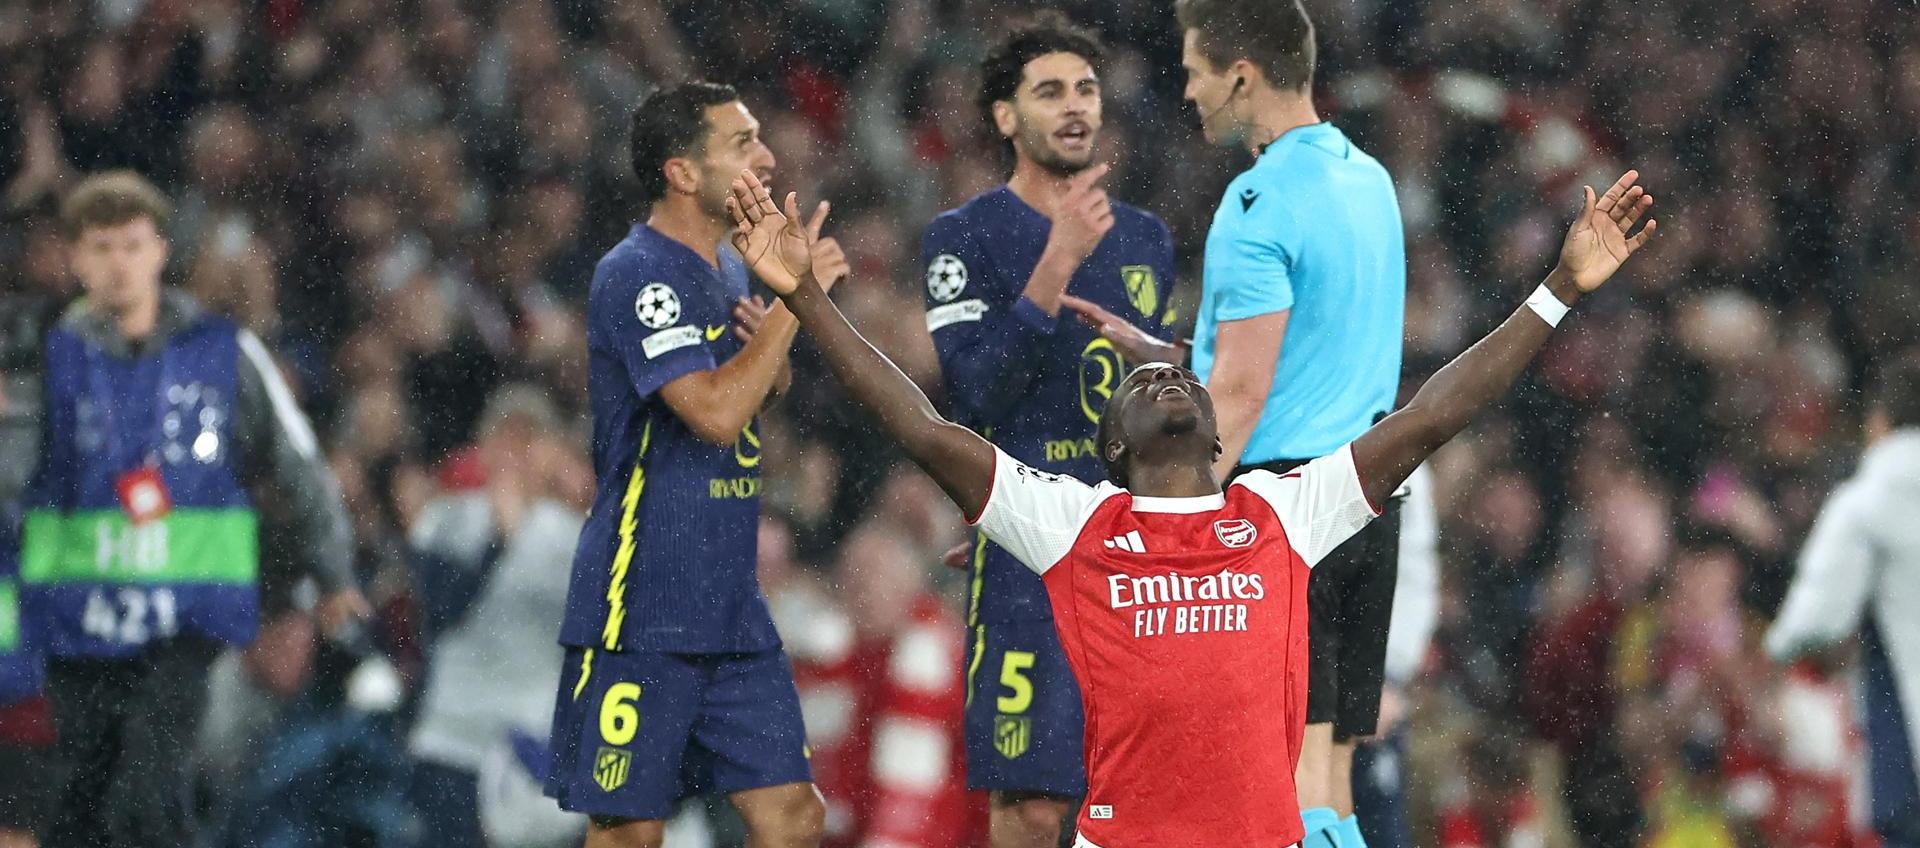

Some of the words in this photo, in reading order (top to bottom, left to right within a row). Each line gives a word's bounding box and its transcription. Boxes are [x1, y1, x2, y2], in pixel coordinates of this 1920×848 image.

[1046, 438, 1097, 461] RIYA
[1107, 568, 1265, 609] Emirates
[1134, 607, 1168, 638] FLY
[1175, 604, 1248, 634] BETTER
[997, 651, 1035, 713] 5
[599, 682, 642, 746] 6
